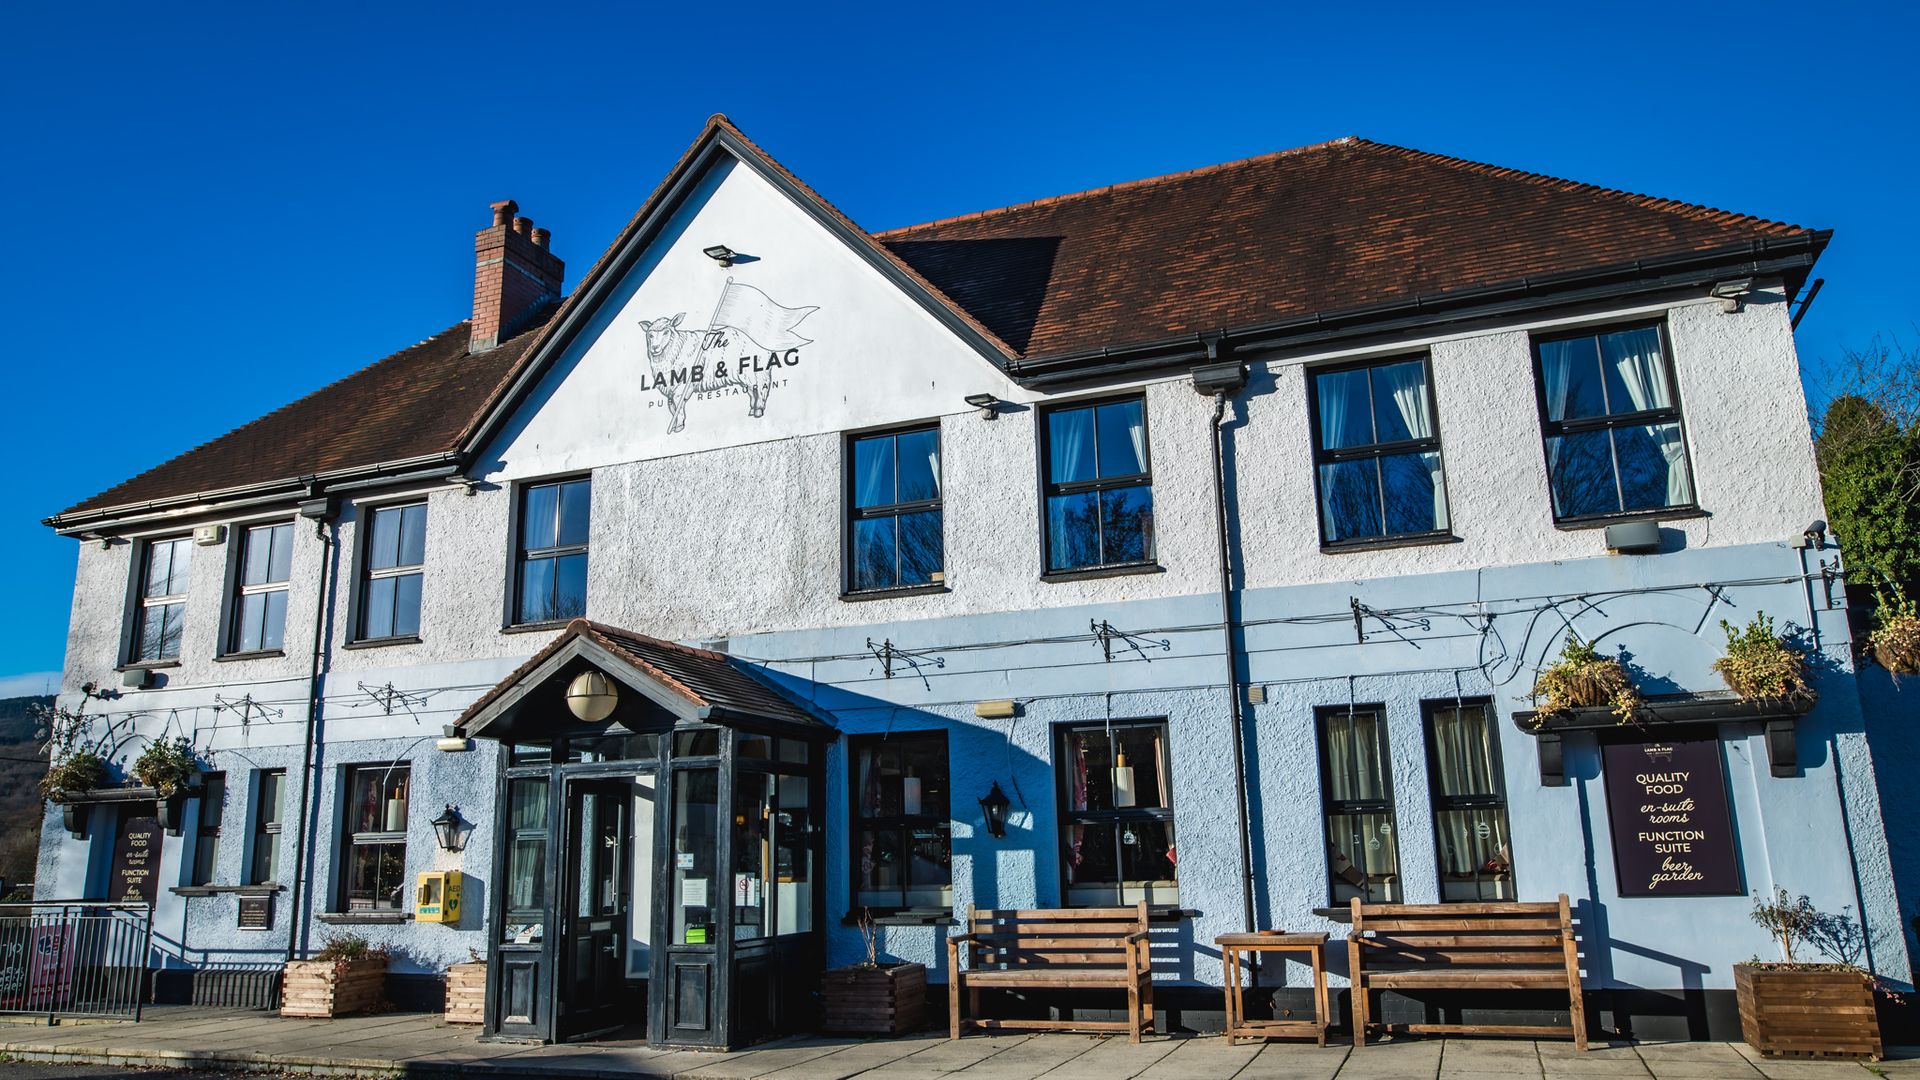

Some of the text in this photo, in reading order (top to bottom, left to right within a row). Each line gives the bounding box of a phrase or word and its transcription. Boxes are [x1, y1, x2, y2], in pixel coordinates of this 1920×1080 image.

[702, 332, 730, 351] The
[640, 348, 800, 391] LAMB & FLAG
[648, 379, 789, 409] PUB RESTAURANT
[1636, 772, 1690, 785] QUALITY
[1645, 784, 1684, 795] FOOD
[1640, 797, 1695, 813] en-suite
[1649, 813, 1690, 824] rooms
[128, 832, 151, 840] QUALITY
[1638, 830, 1705, 842] FUNCTION
[1655, 843, 1692, 853] SUITE
[1661, 856, 1692, 871] beer
[1648, 866, 1704, 889] garden
[448, 885, 461, 893] AED
